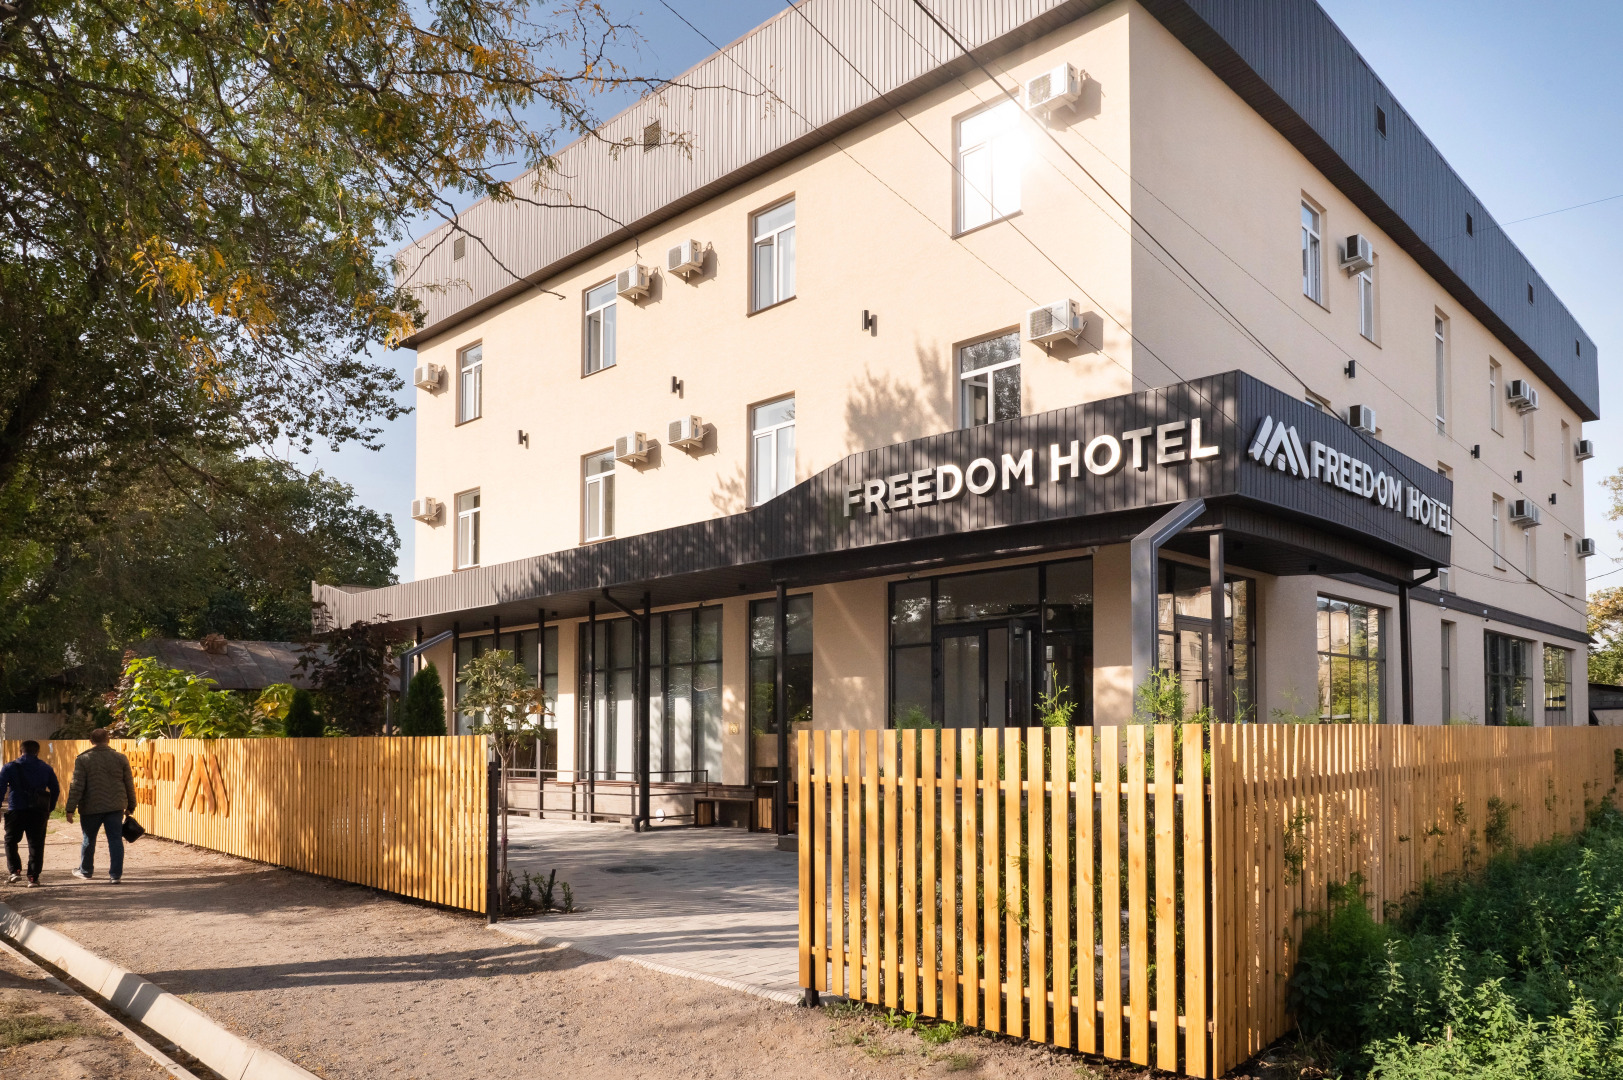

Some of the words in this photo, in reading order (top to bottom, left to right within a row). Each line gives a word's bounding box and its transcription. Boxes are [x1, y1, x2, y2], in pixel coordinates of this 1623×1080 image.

[843, 449, 1034, 518] FREEDOM
[1050, 417, 1220, 483] HOTEL
[1310, 440, 1402, 512] FREEDOM
[1406, 486, 1453, 537] HOTEL
